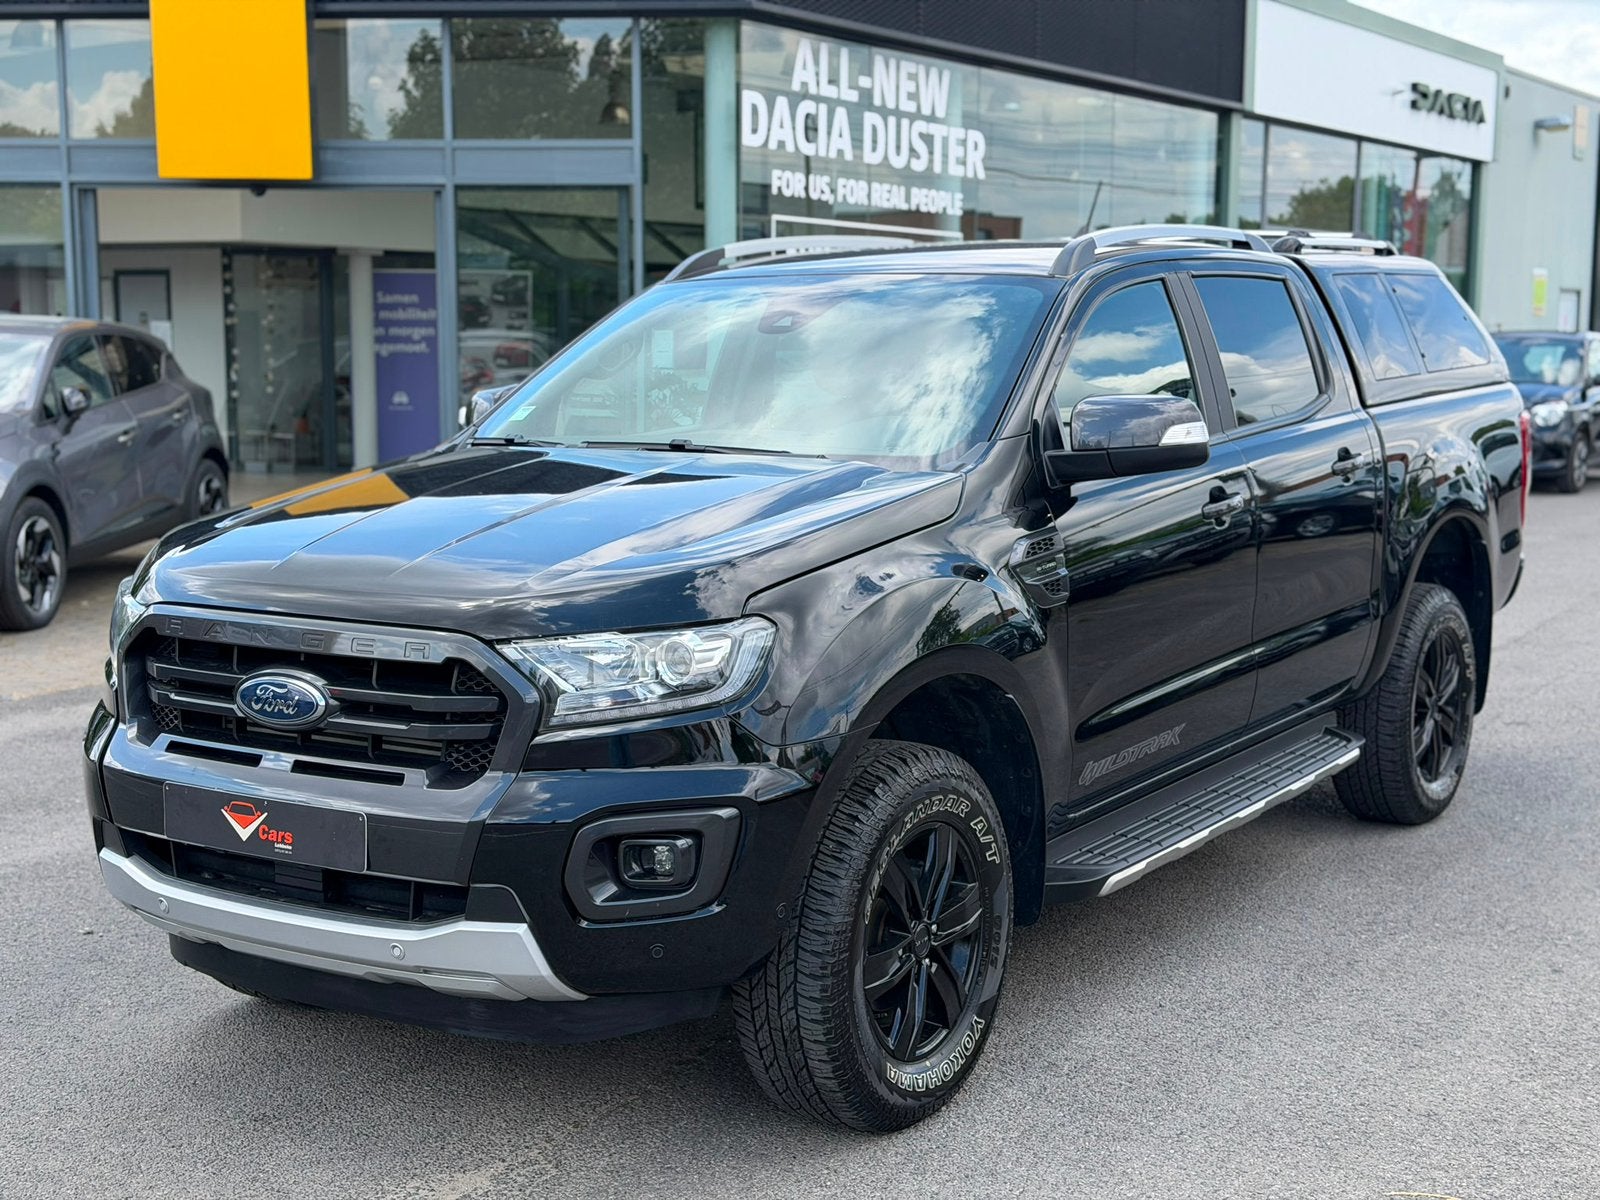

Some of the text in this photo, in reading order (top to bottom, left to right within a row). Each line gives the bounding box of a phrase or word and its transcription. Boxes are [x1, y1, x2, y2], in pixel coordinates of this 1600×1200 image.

[791, 37, 950, 118] ALL-NEW
[1411, 82, 1486, 124] DACIA
[741, 89, 986, 180] DACIA DUSTER
[771, 169, 964, 216] FOR US, FOR REAL PEOPLE
[165, 617, 432, 660] RANGER
[249, 683, 300, 717] Ford
[1078, 722, 1186, 786] WILDTRAK
[258, 824, 294, 844] Cars
[970, 816, 1001, 864] A/T
[886, 1014, 986, 1092] YOKOHAMA
